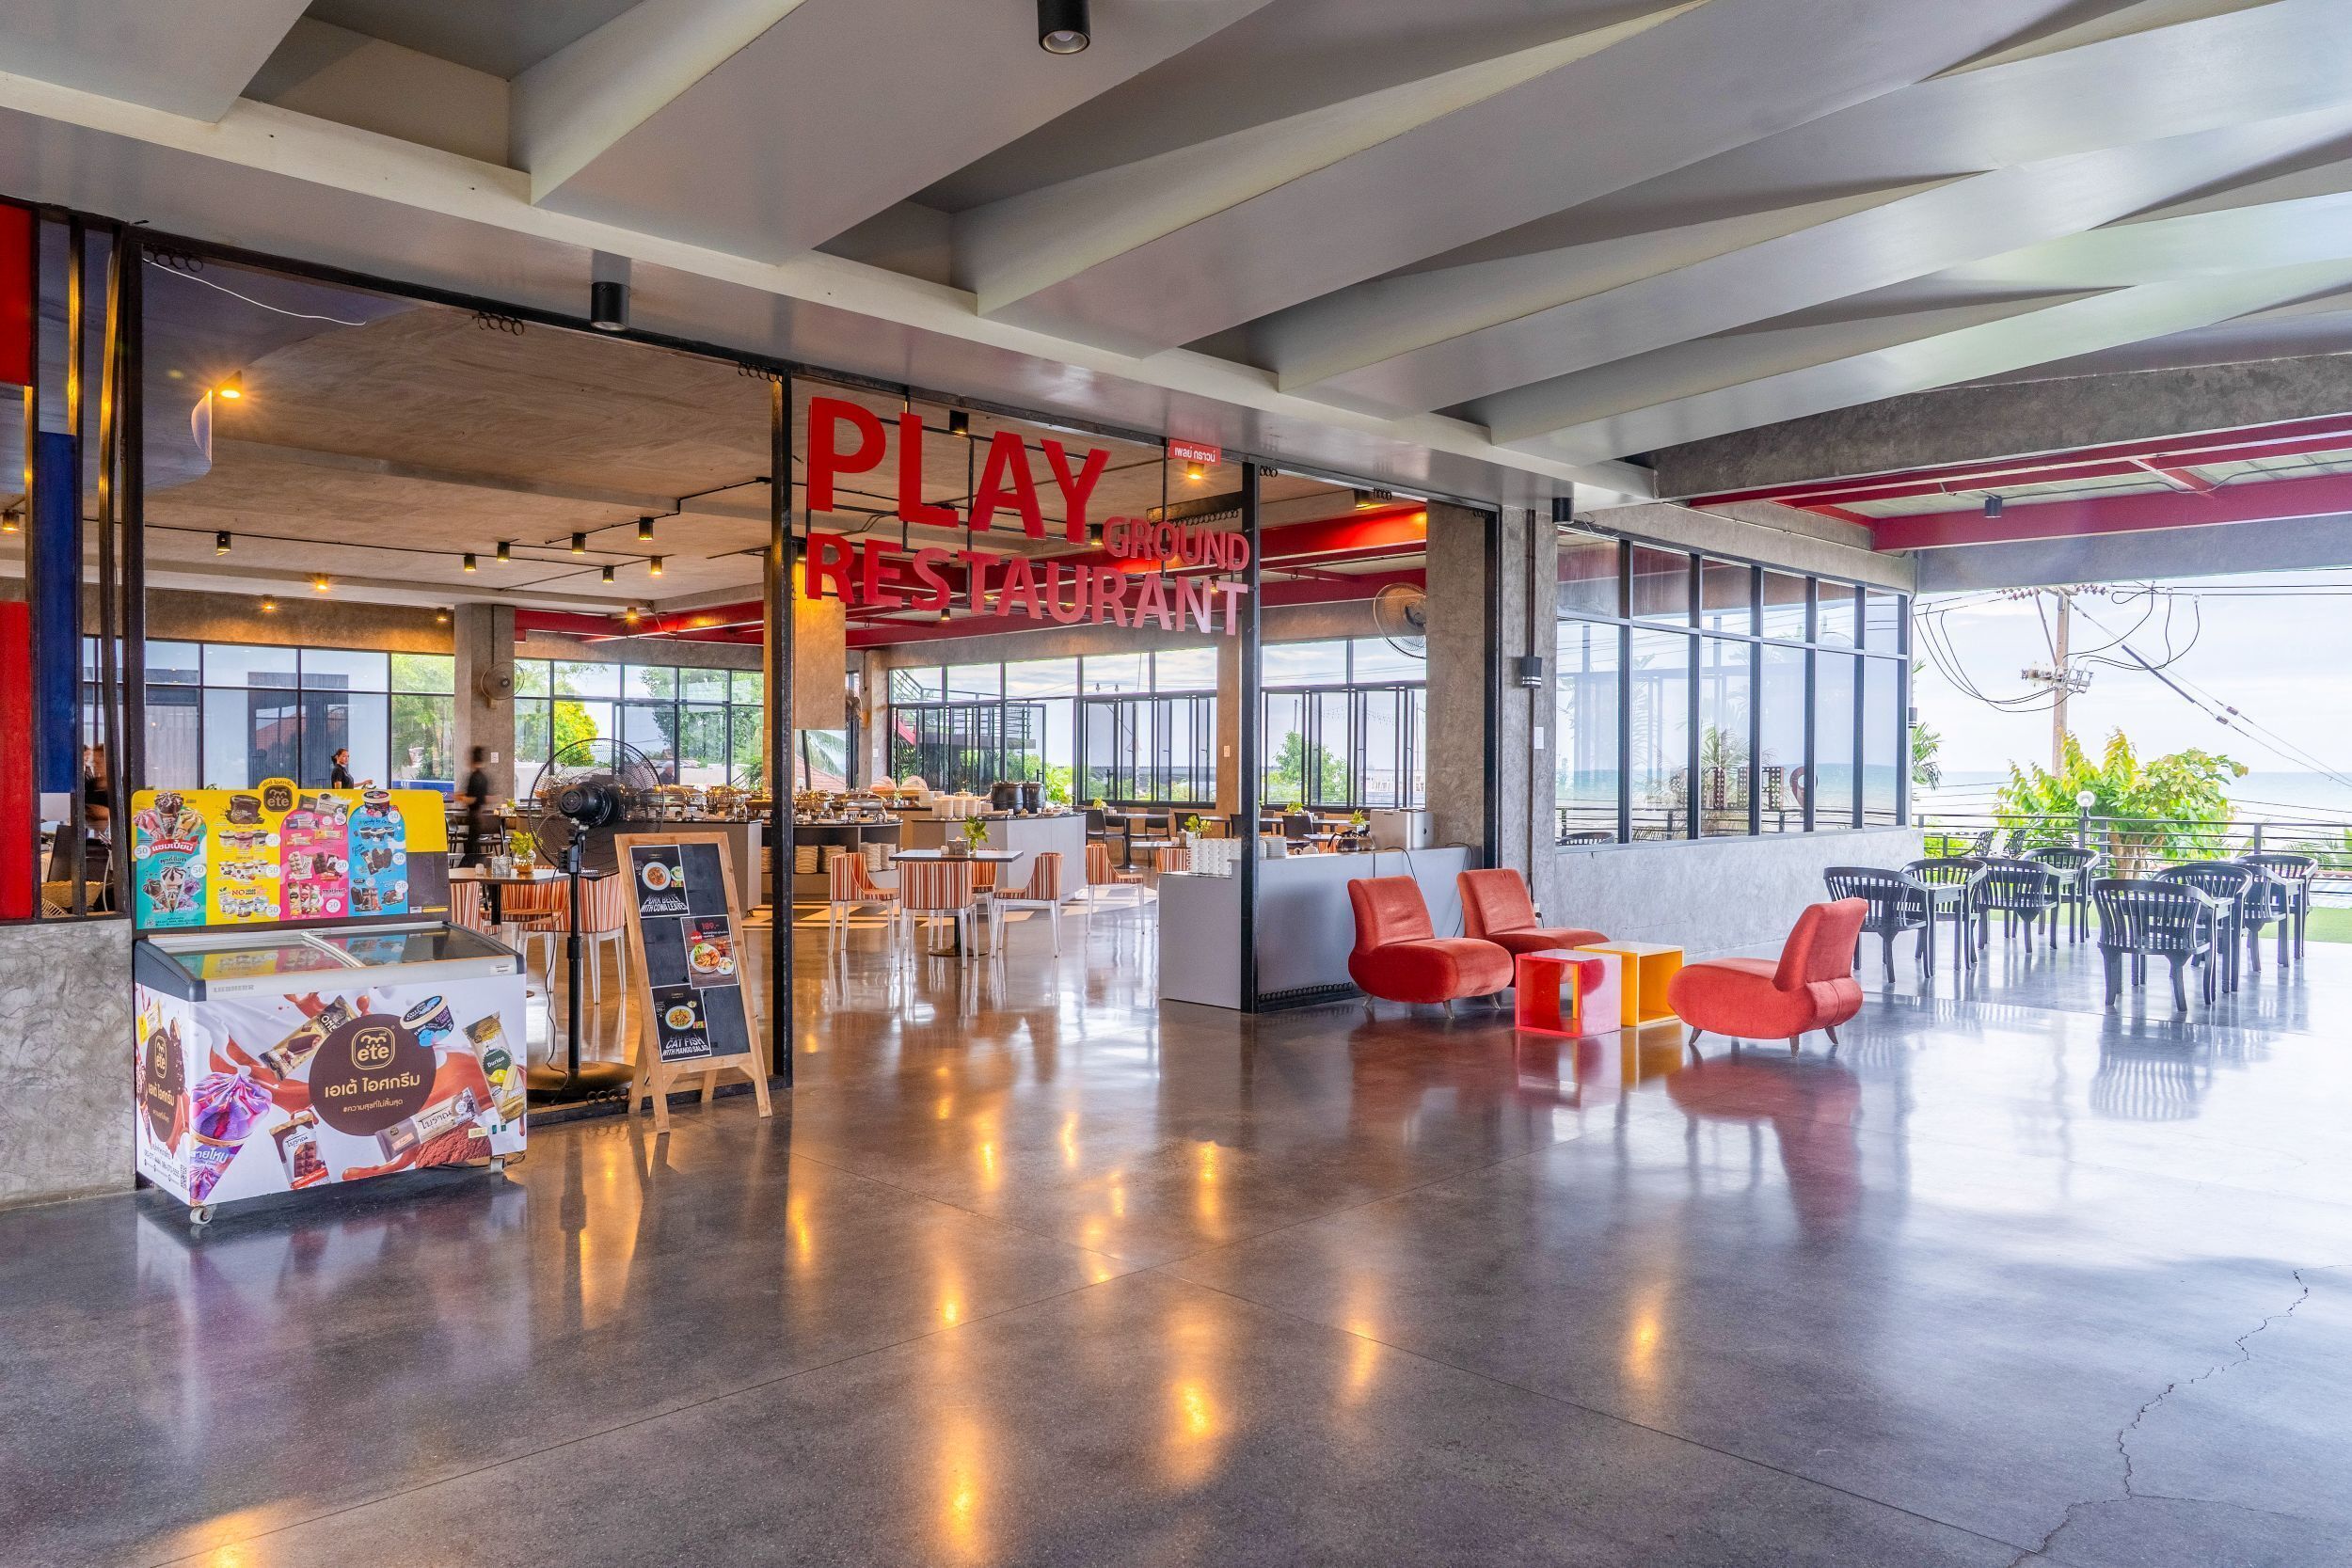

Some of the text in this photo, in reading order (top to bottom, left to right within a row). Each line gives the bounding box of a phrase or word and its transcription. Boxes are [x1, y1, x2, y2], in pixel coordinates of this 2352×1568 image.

[807, 396, 1111, 545] PLAY
[1103, 515, 1249, 572] GROUND
[806, 532, 1248, 635] RESTAURANT
[321, 1015, 338, 1033] ONE
[665, 1039, 683, 1050] CAT
[684, 1037, 705, 1047] FISH
[486, 1056, 505, 1068] Durian
[325, 1071, 421, 1098] เอเต้ ไอศกรีม
